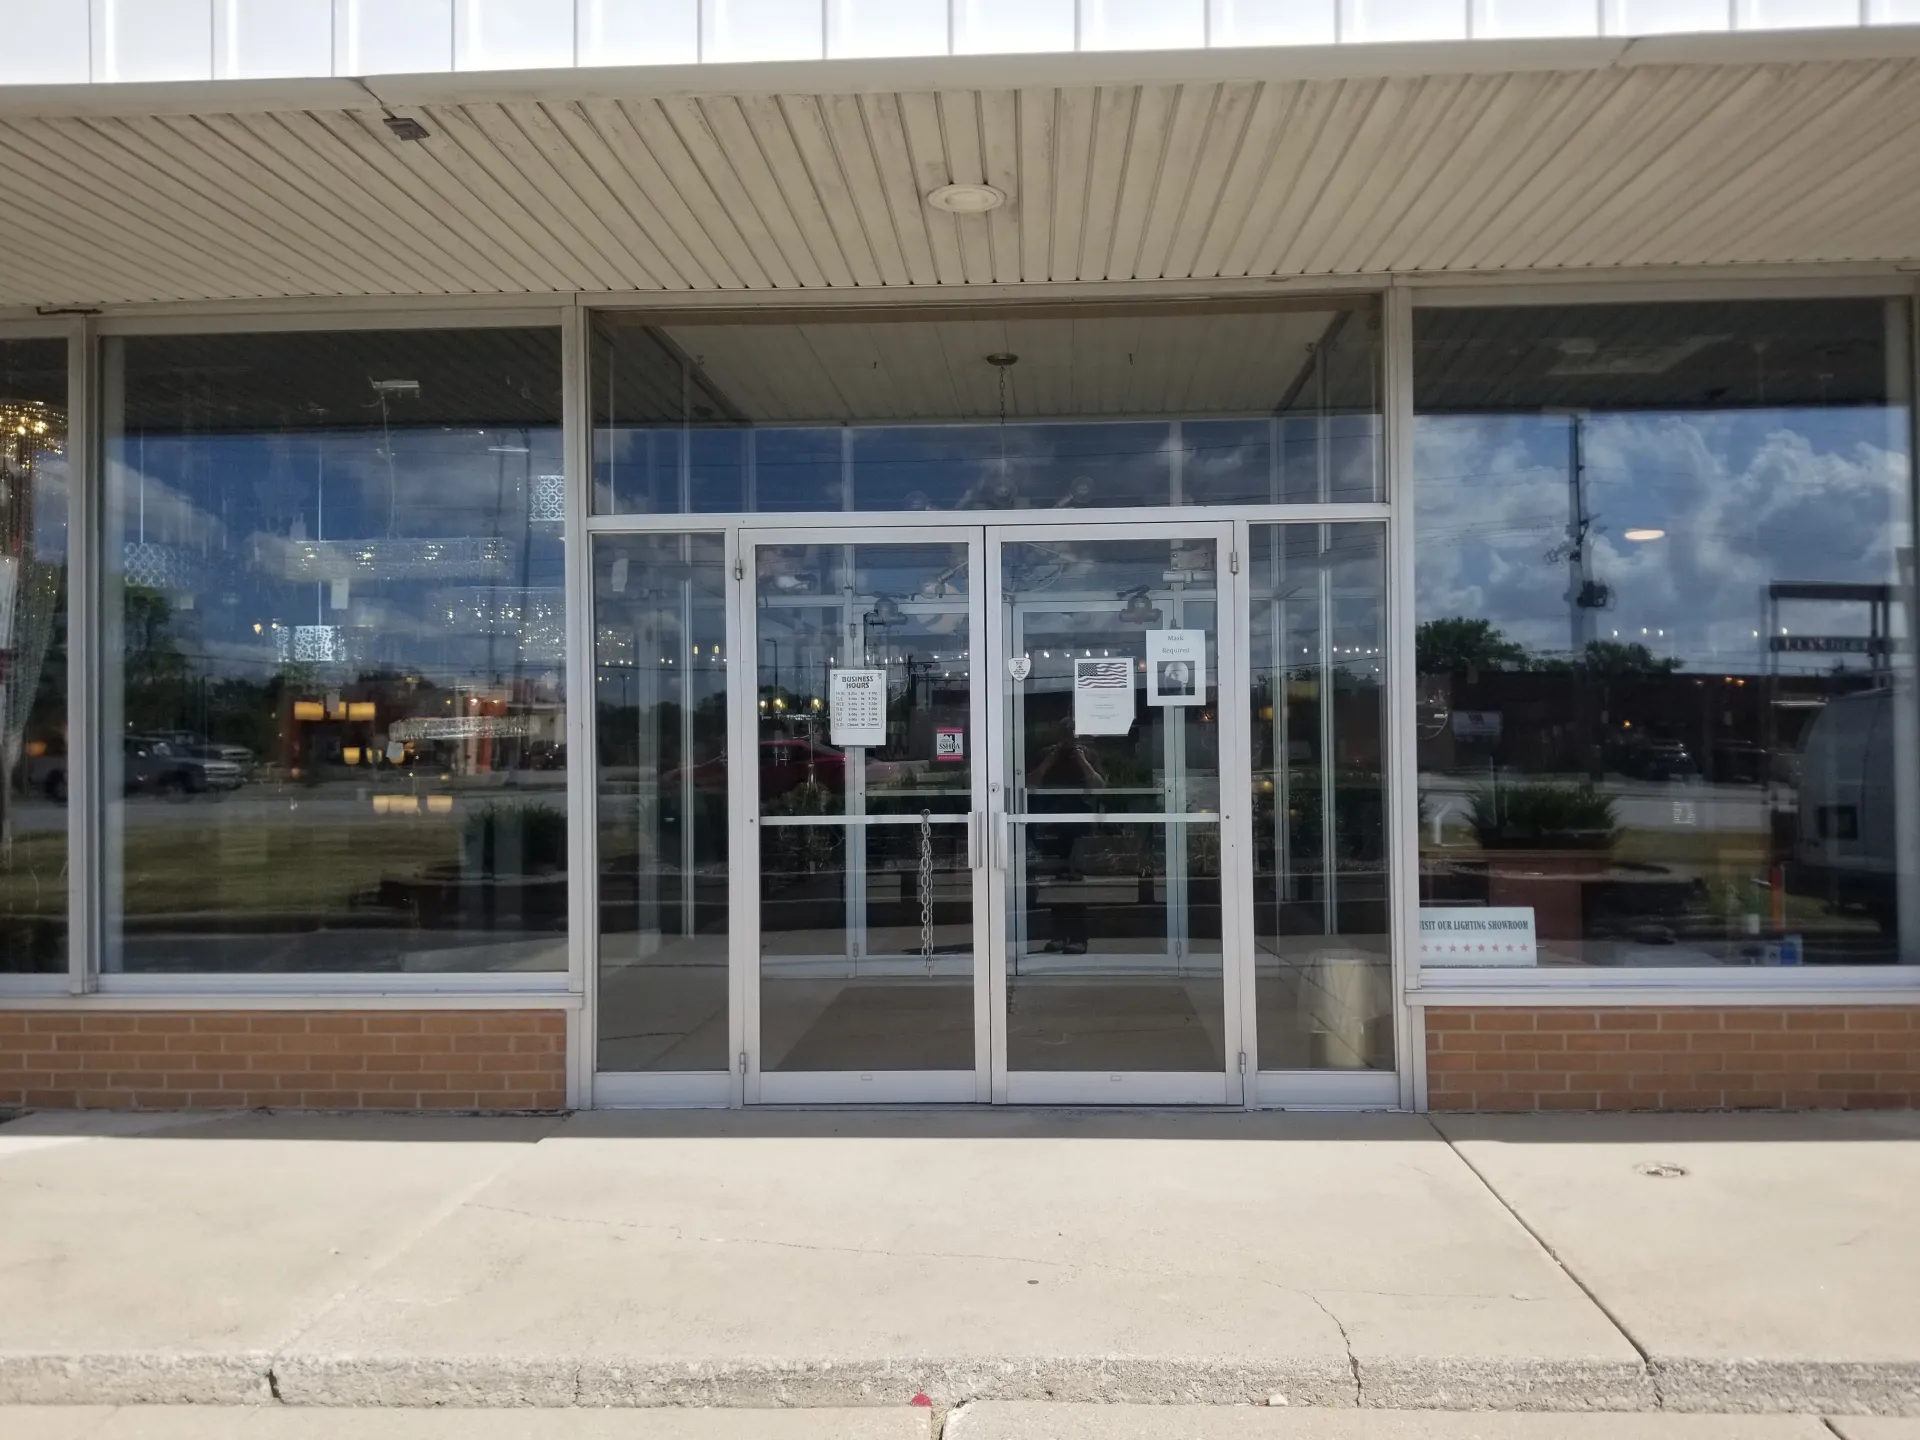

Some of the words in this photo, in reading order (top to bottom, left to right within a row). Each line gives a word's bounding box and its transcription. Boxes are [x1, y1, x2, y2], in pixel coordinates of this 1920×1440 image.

[1162, 647, 1190, 655] Required
[841, 675, 874, 683] BUSINESS
[1438, 920, 1453, 931] OUR
[1454, 920, 1487, 931] LIGHTING
[1488, 920, 1529, 930] SHOWROOM
